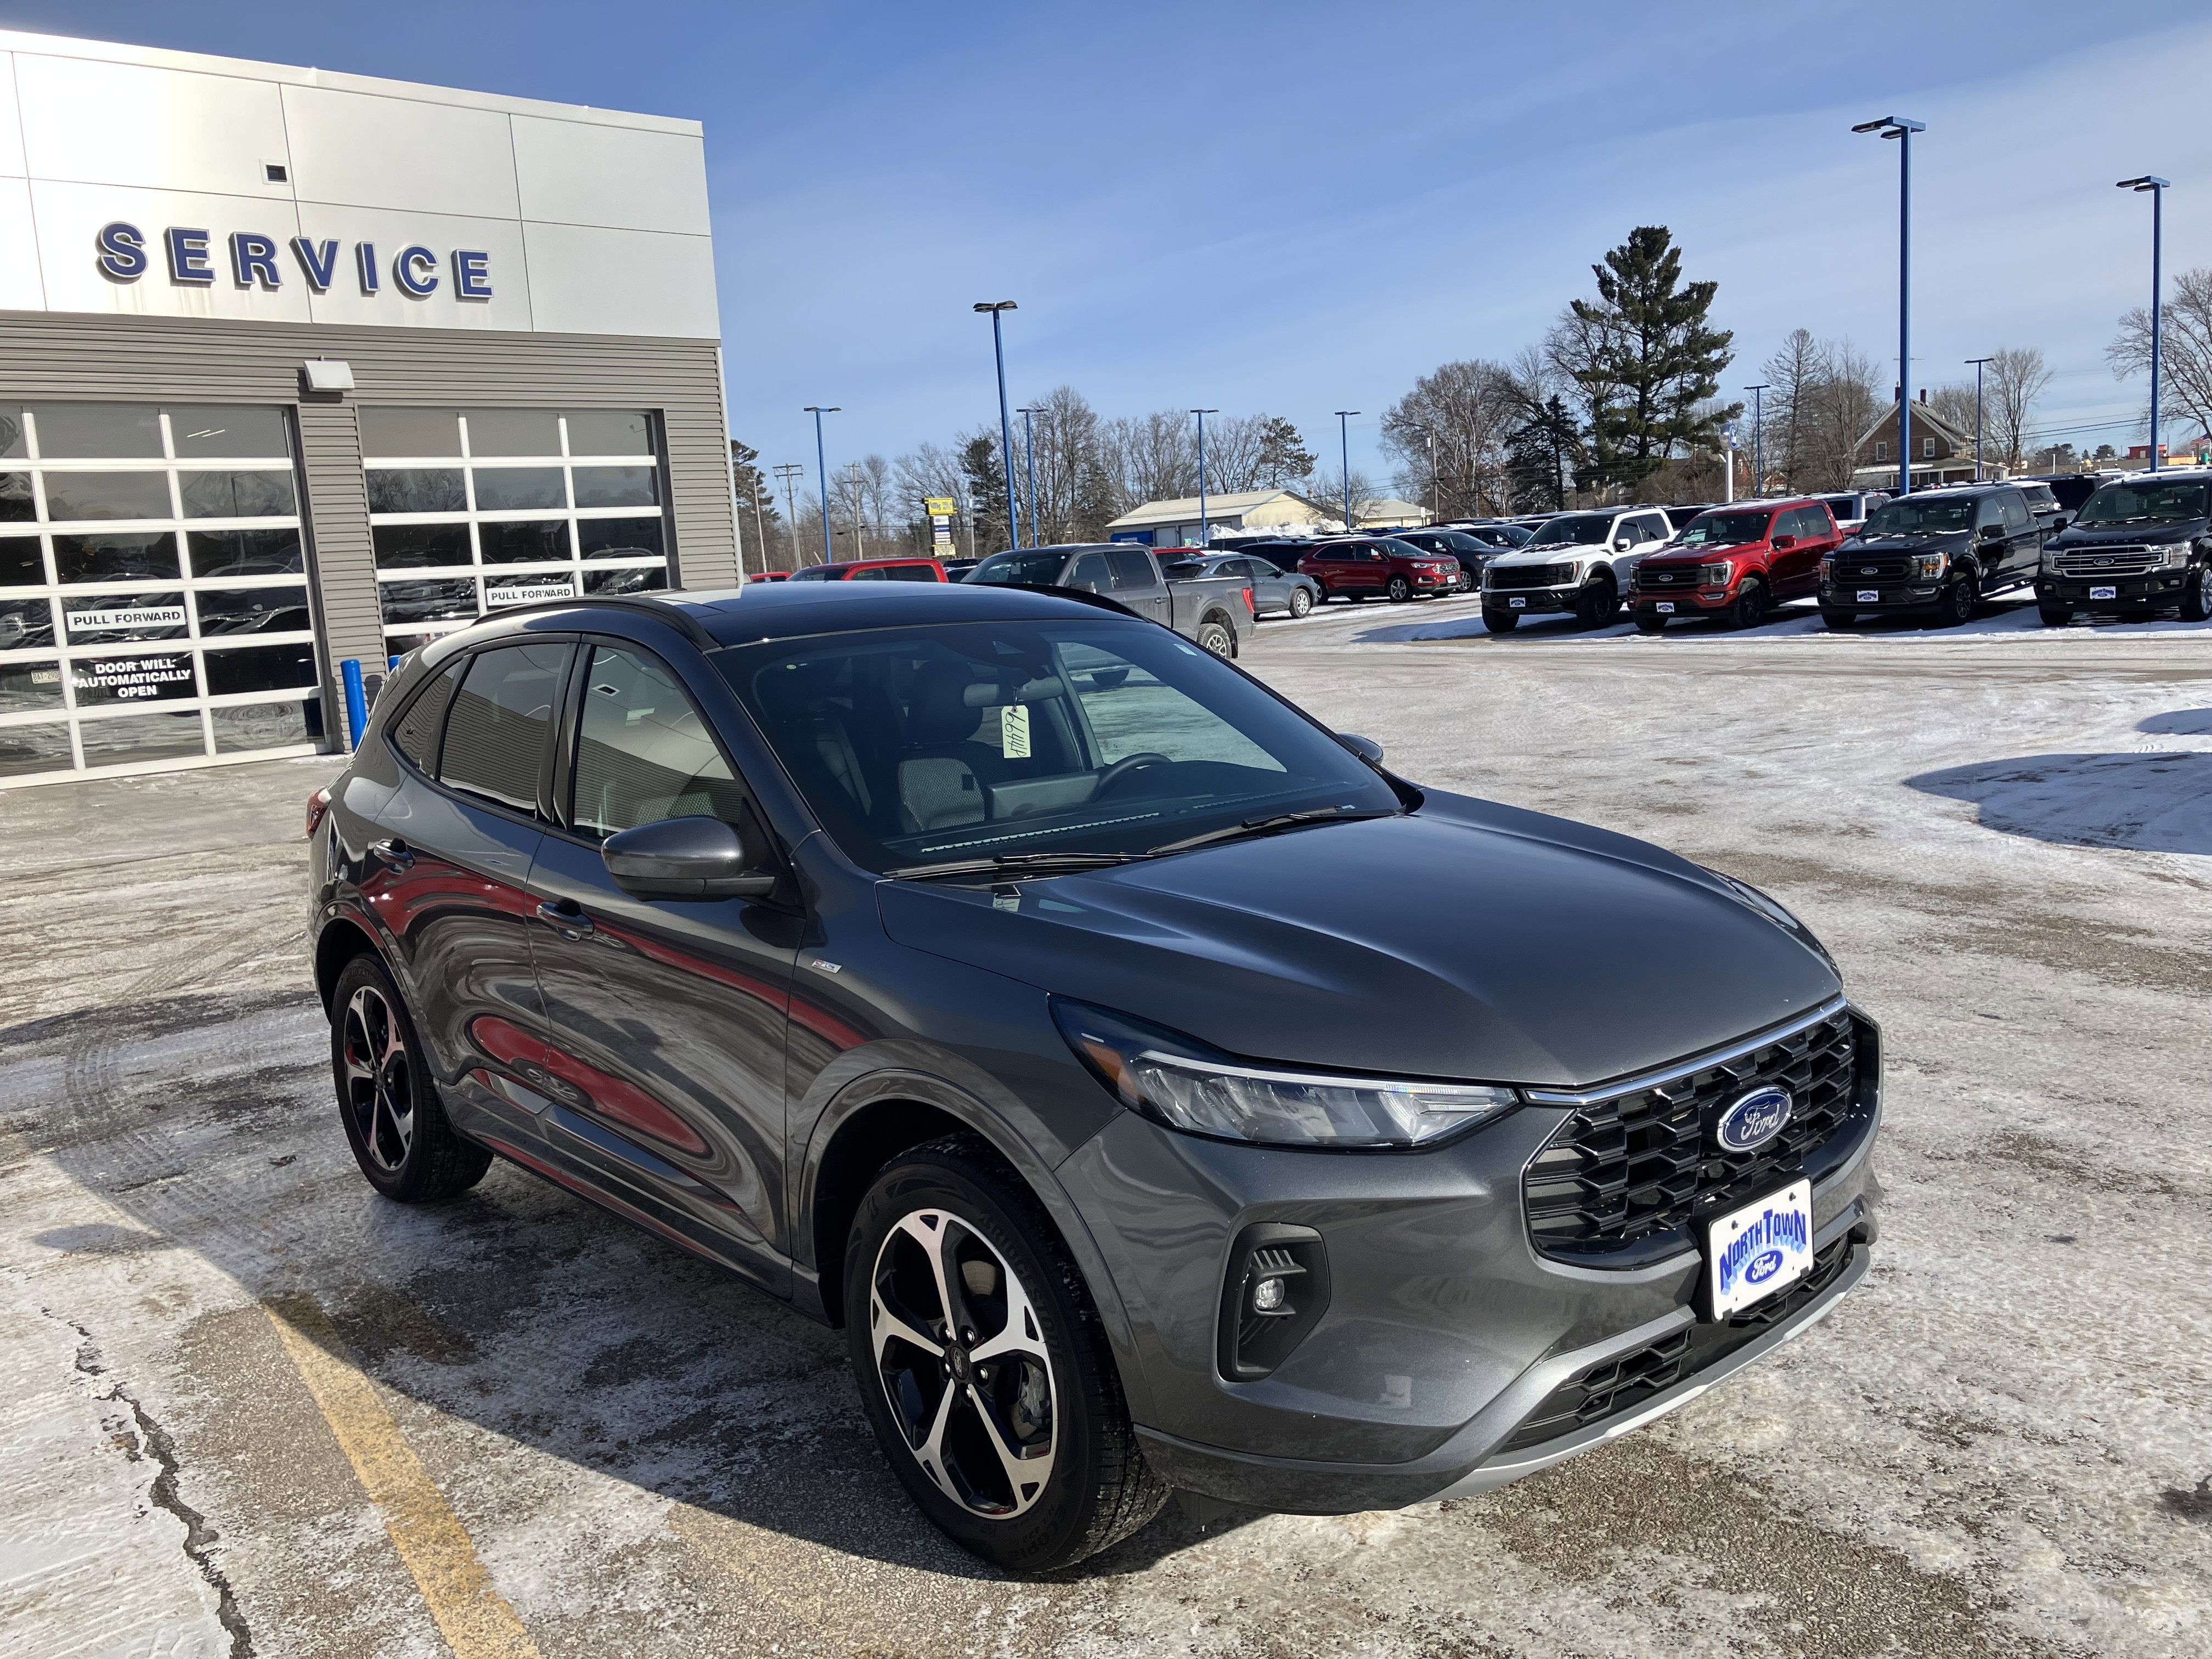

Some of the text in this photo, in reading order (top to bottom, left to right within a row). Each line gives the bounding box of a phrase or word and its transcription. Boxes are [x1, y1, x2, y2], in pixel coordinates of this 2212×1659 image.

[95, 221, 495, 304] SERVICE
[492, 589, 570, 600] PULL FORWARD
[74, 611, 180, 625] PULL FORWARD
[95, 658, 176, 674] DOOR WILL
[78, 669, 191, 689] AUTOMATICALLY
[117, 685, 157, 698] OPEN
[1741, 1101, 1780, 1141] Ford
[1752, 1254, 1777, 1280] Ford
